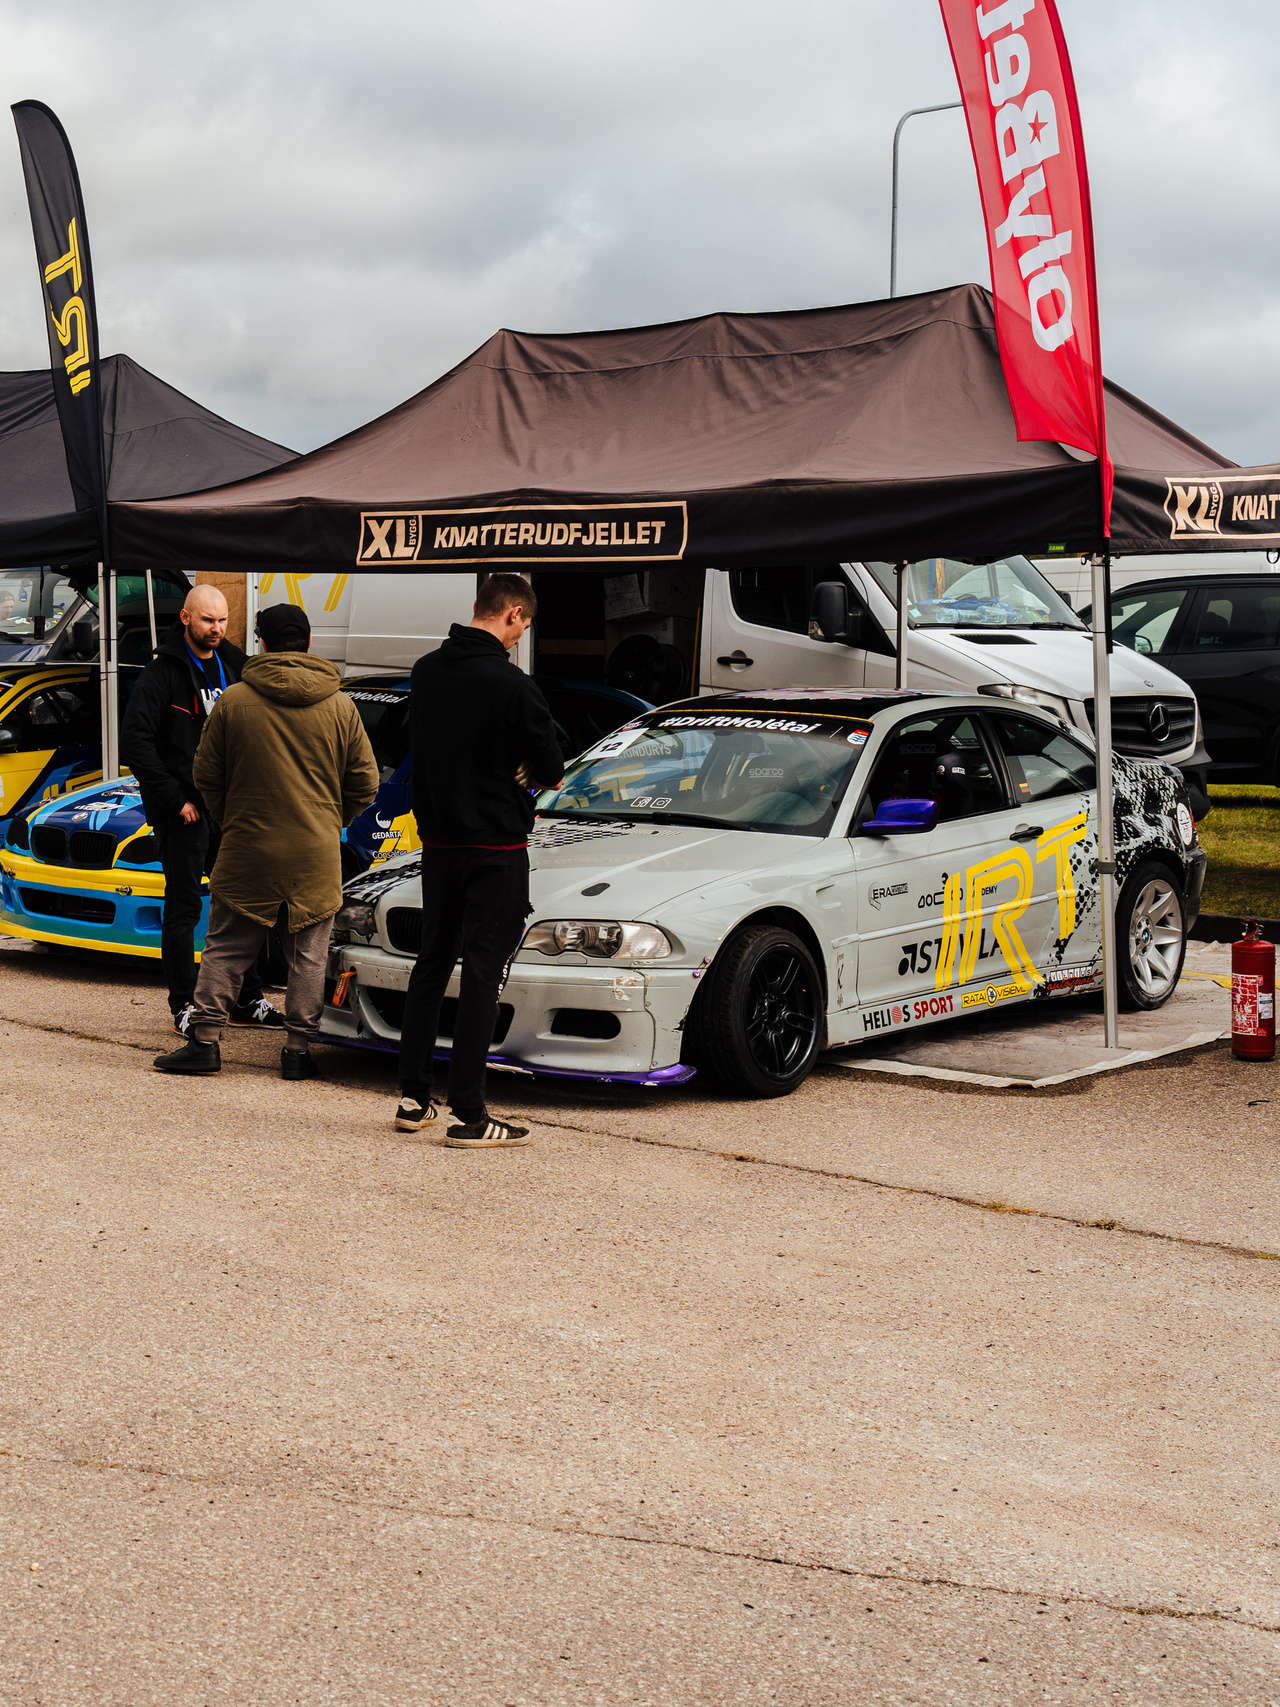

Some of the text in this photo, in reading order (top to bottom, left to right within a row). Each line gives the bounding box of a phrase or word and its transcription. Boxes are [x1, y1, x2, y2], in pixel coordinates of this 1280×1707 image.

[1173, 485, 1216, 531] XL
[1208, 483, 1220, 517] BYGG
[1231, 494, 1280, 521] KNAT
[361, 518, 415, 559] XL
[408, 518, 417, 546] BYGG
[433, 520, 666, 548] KNATTERUDFJELLET
[600, 741, 624, 752] 12
[372, 831, 402, 840] GEDARTA
[872, 886, 891, 899] ERA
[862, 995, 954, 1031] HELIOS SPORT
[964, 993, 986, 1005] RATAI
